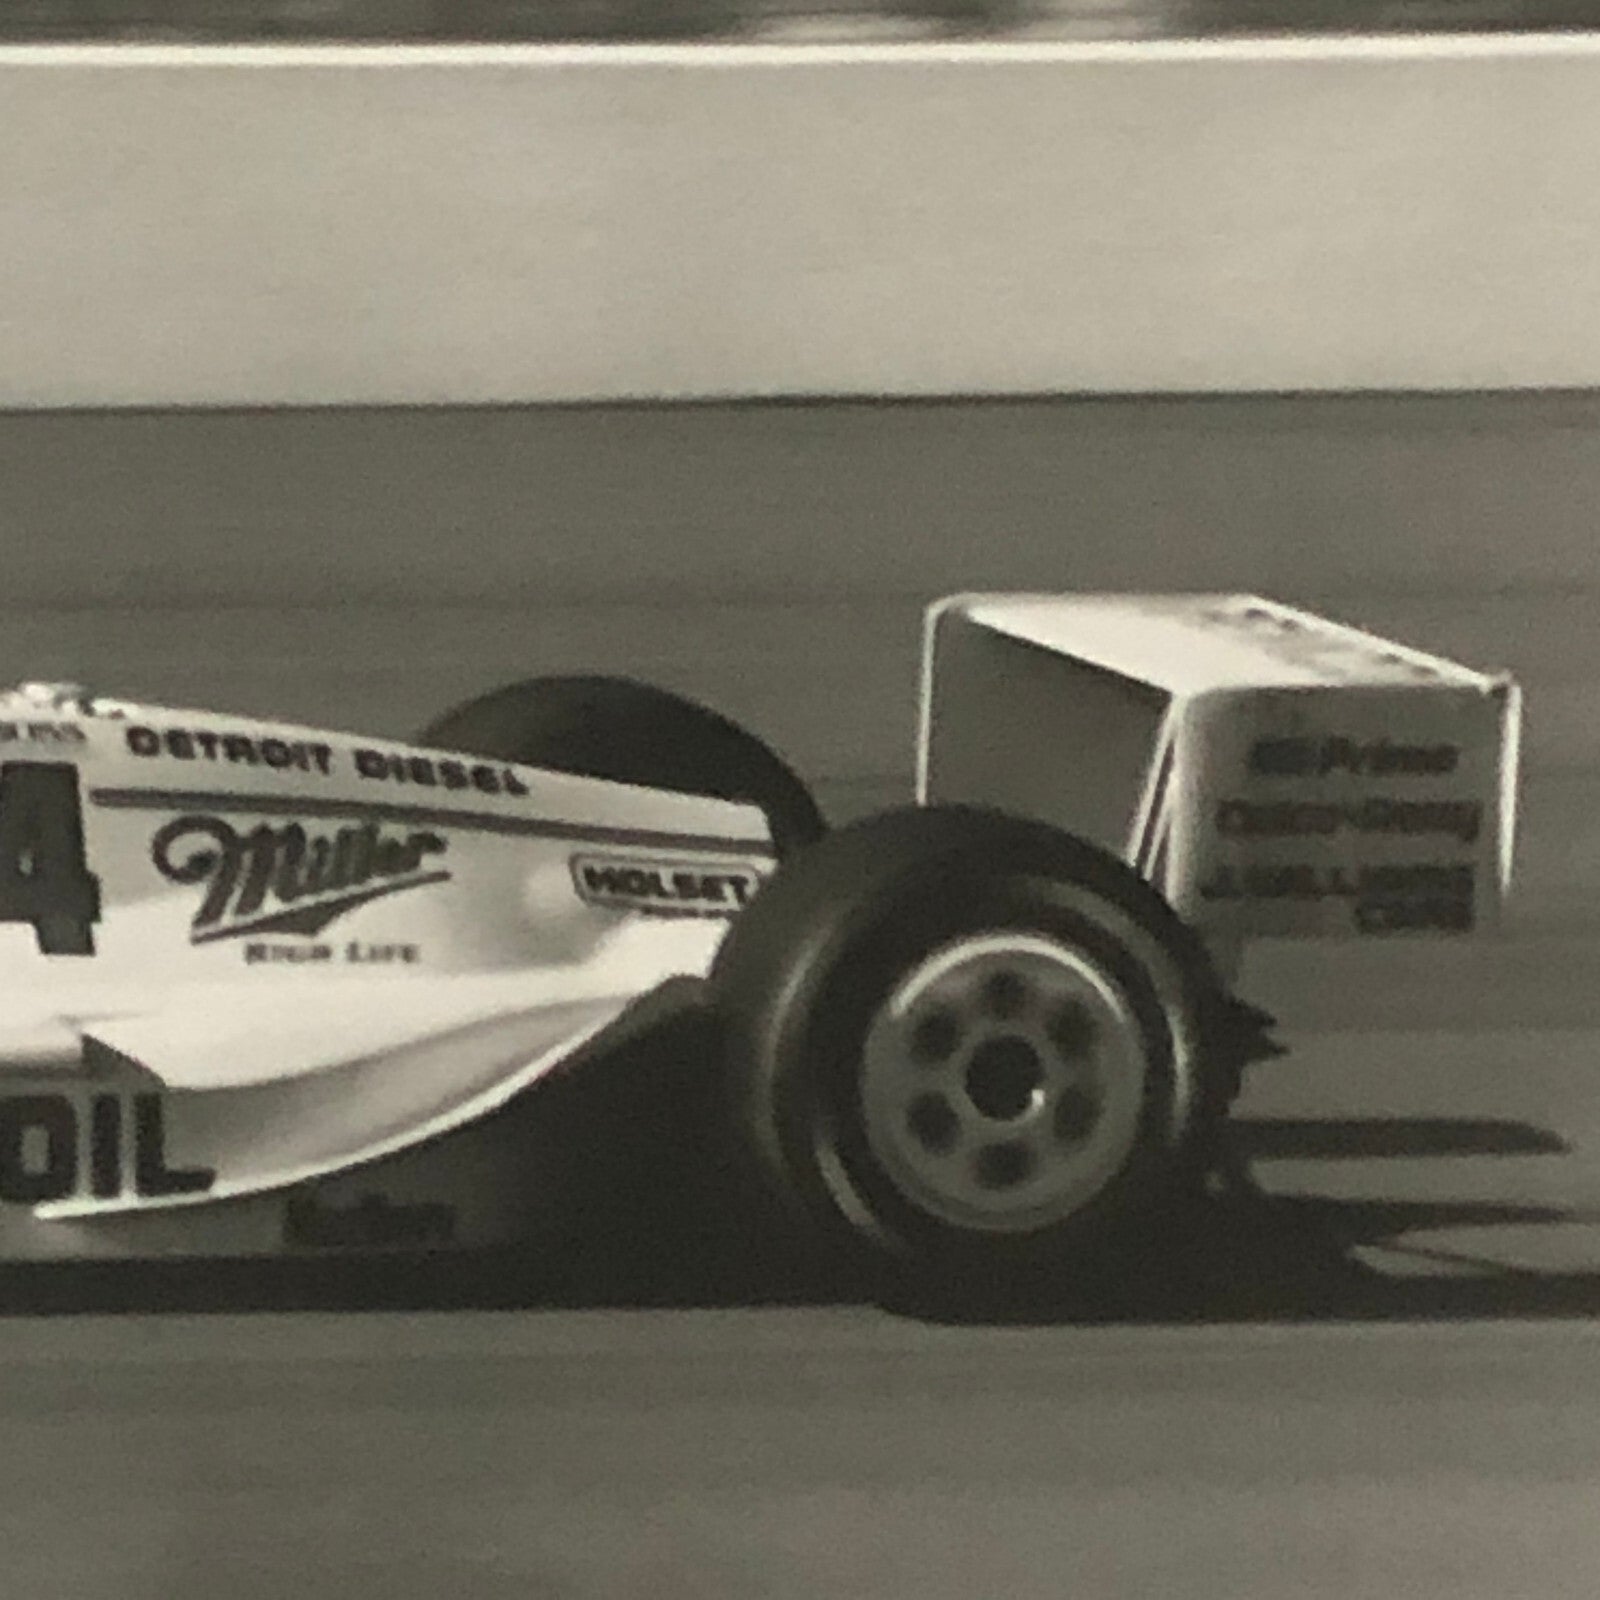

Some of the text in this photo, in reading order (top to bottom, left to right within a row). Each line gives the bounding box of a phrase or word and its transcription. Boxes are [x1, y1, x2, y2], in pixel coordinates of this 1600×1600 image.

[126, 726, 331, 774] DETROIT
[354, 748, 529, 796] DIESEL
[0, 760, 100, 956] 4
[152, 815, 449, 927] Miller
[583, 866, 750, 904] HOLSET
